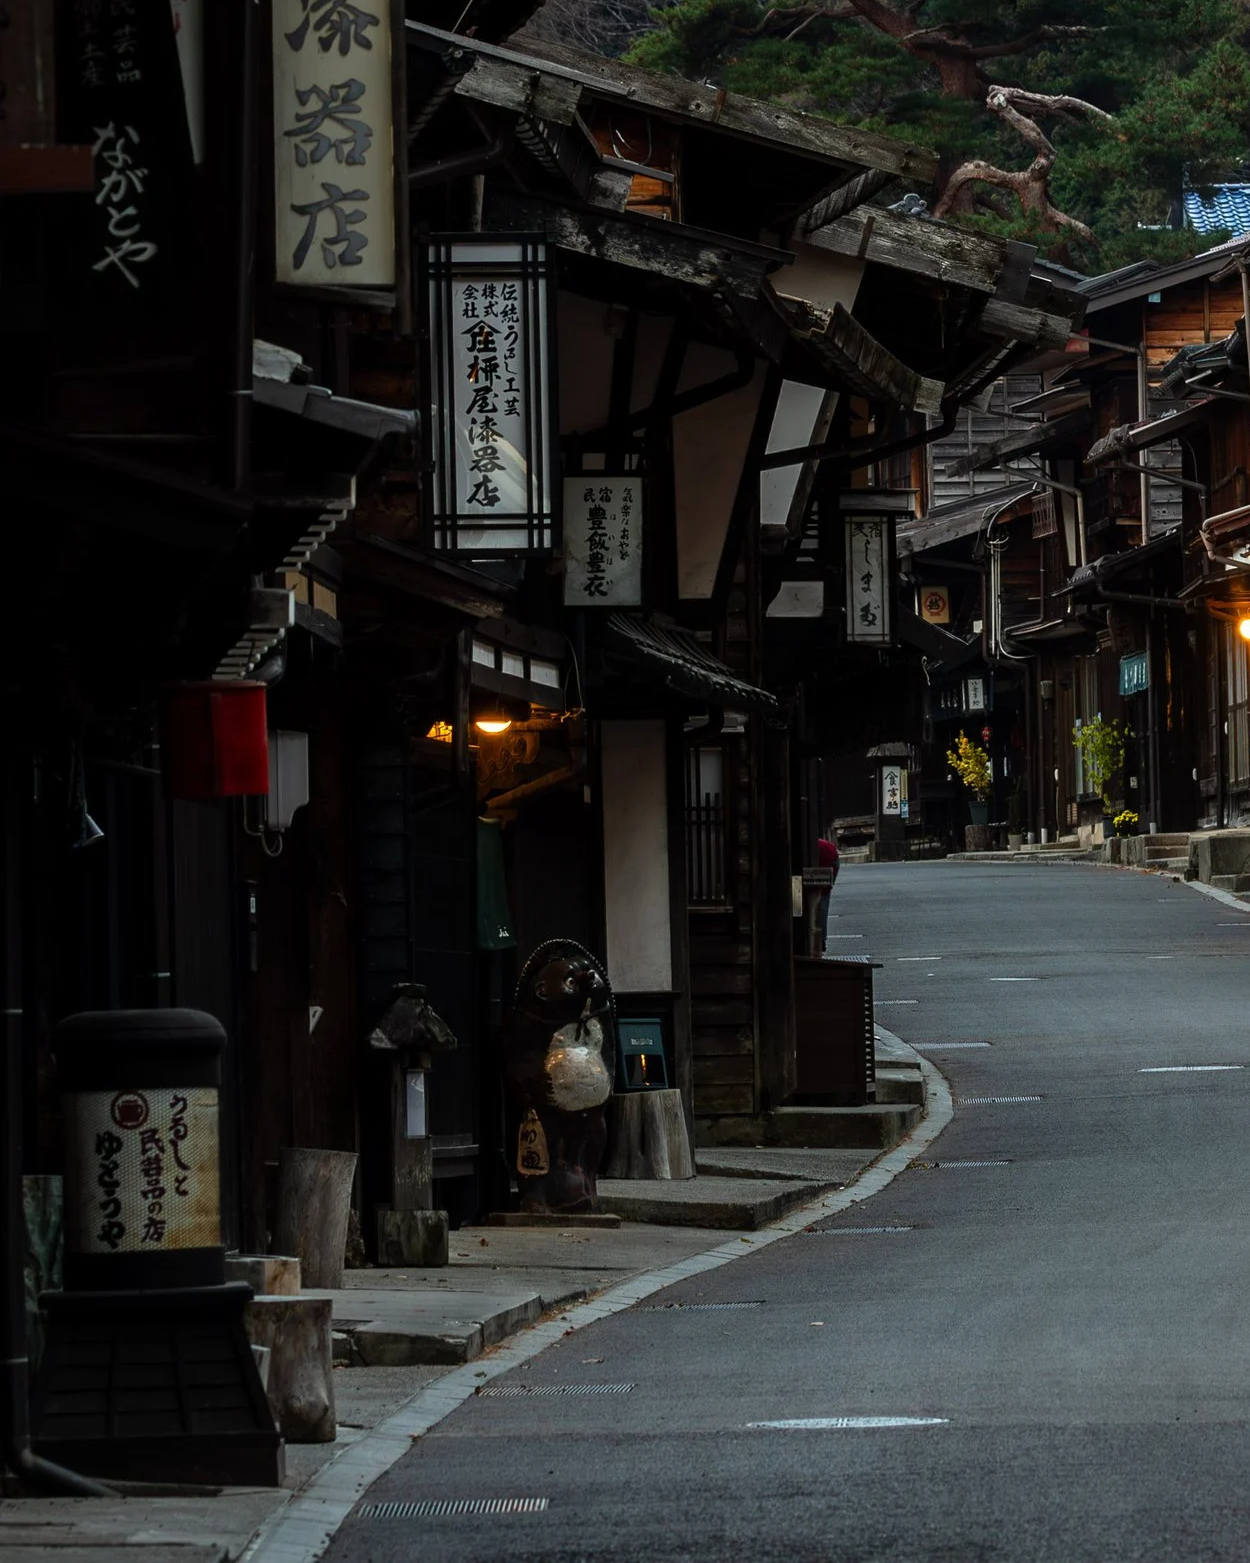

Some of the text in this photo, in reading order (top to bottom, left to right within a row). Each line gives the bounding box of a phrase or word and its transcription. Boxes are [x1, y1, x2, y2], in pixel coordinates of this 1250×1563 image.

[92, 121, 158, 288] ながとや
[139, 1128, 165, 1243] 民芸品の店
[170, 1094, 189, 1196] うるしと
